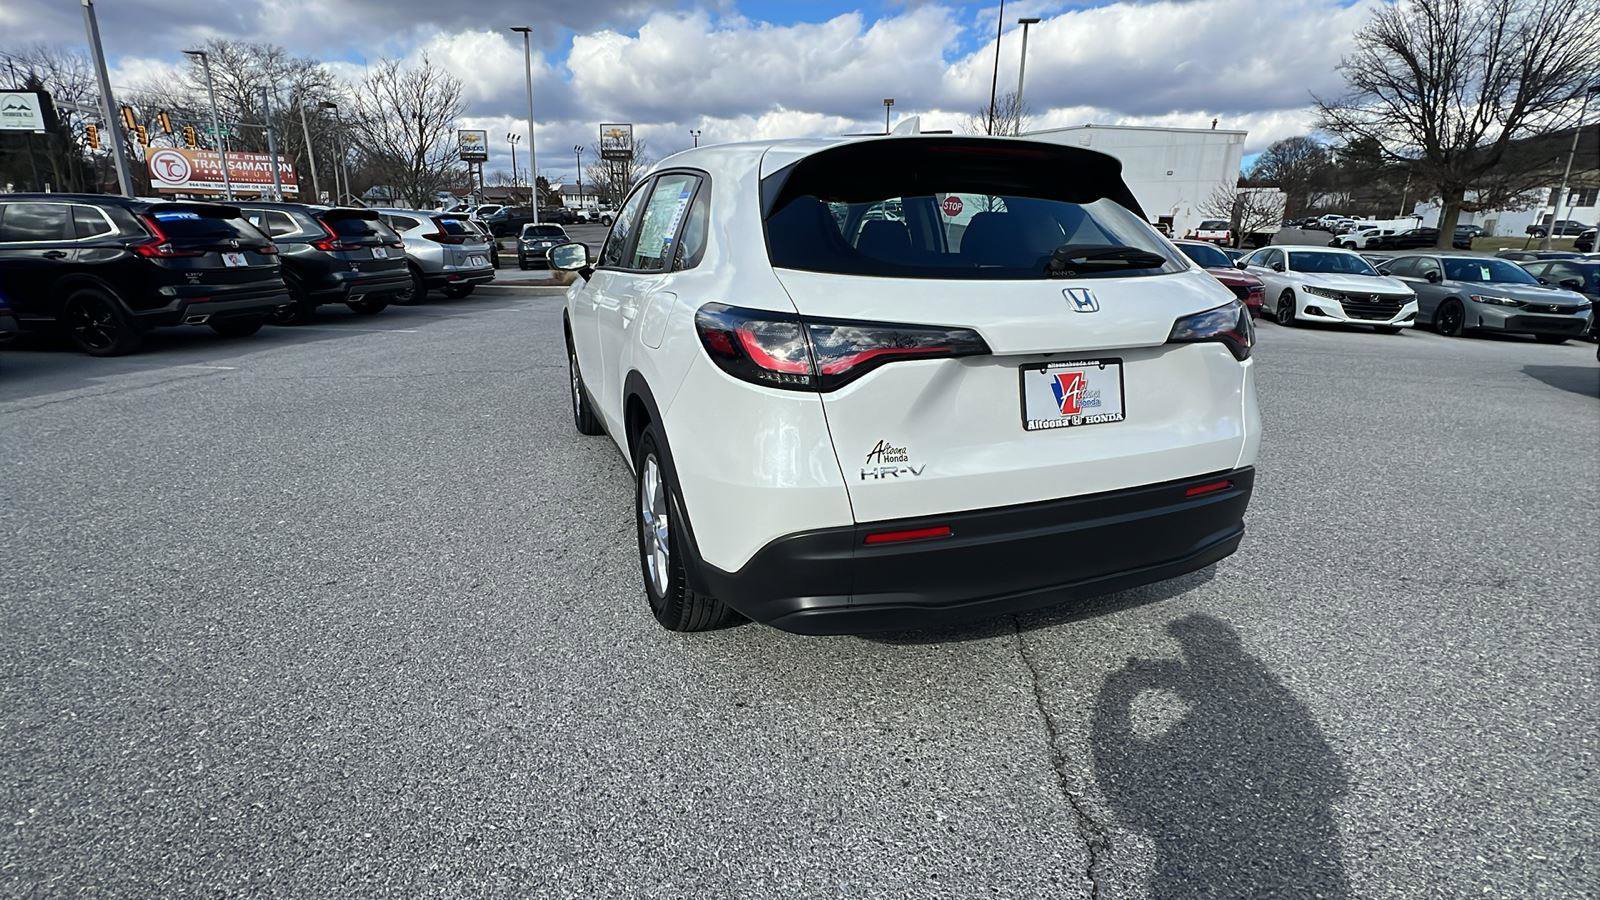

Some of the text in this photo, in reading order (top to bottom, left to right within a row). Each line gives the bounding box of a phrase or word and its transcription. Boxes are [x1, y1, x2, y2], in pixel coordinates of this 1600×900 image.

[231, 170, 294, 179] CHURH
[943, 201, 962, 211] STOP
[1047, 360, 1101, 369] altoonahonda.com
[1027, 417, 1070, 431] Altoona
[1085, 413, 1124, 424] HONDA
[866, 439, 907, 464] Altoona
[883, 454, 909, 464] Honda
[860, 463, 927, 481] HR-V
